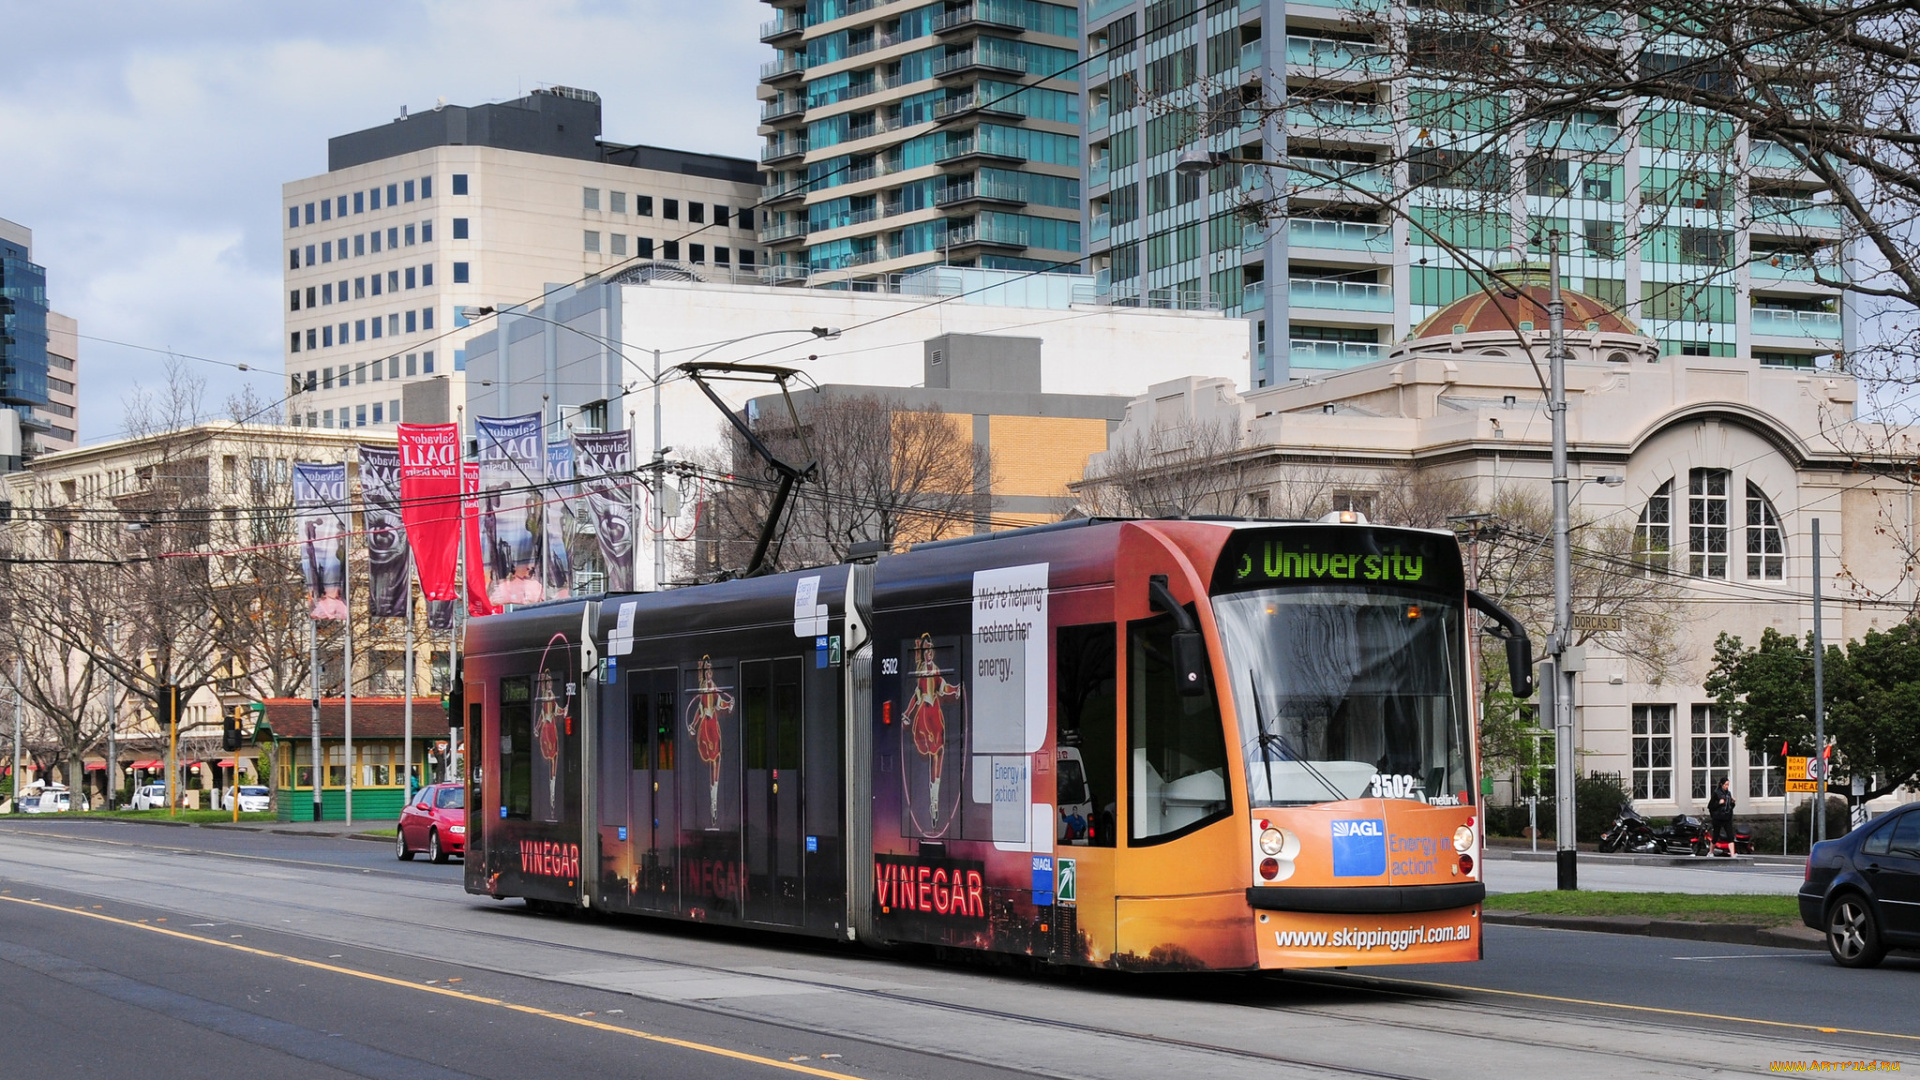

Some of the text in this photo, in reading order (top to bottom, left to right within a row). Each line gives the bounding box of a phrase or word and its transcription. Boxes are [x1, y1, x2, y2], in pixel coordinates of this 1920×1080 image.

[1264, 541, 1423, 580] University
[979, 583, 1043, 612] We're helping
[978, 618, 1032, 643] restore her
[1575, 616, 1621, 629] DORCAS ST
[882, 658, 898, 674] 3502
[978, 657, 1013, 683] energy.
[995, 762, 1026, 785] Energy in
[1371, 774, 1414, 798] 3502
[1429, 794, 1459, 805] metlink
[1350, 822, 1382, 836] AGL
[1389, 834, 1450, 856] Energy in
[520, 840, 579, 878] VINEGAR
[1039, 858, 1052, 870] AGL
[876, 863, 984, 917] VINEGAR
[1275, 924, 1470, 950] www.skippinggirl.com.au
